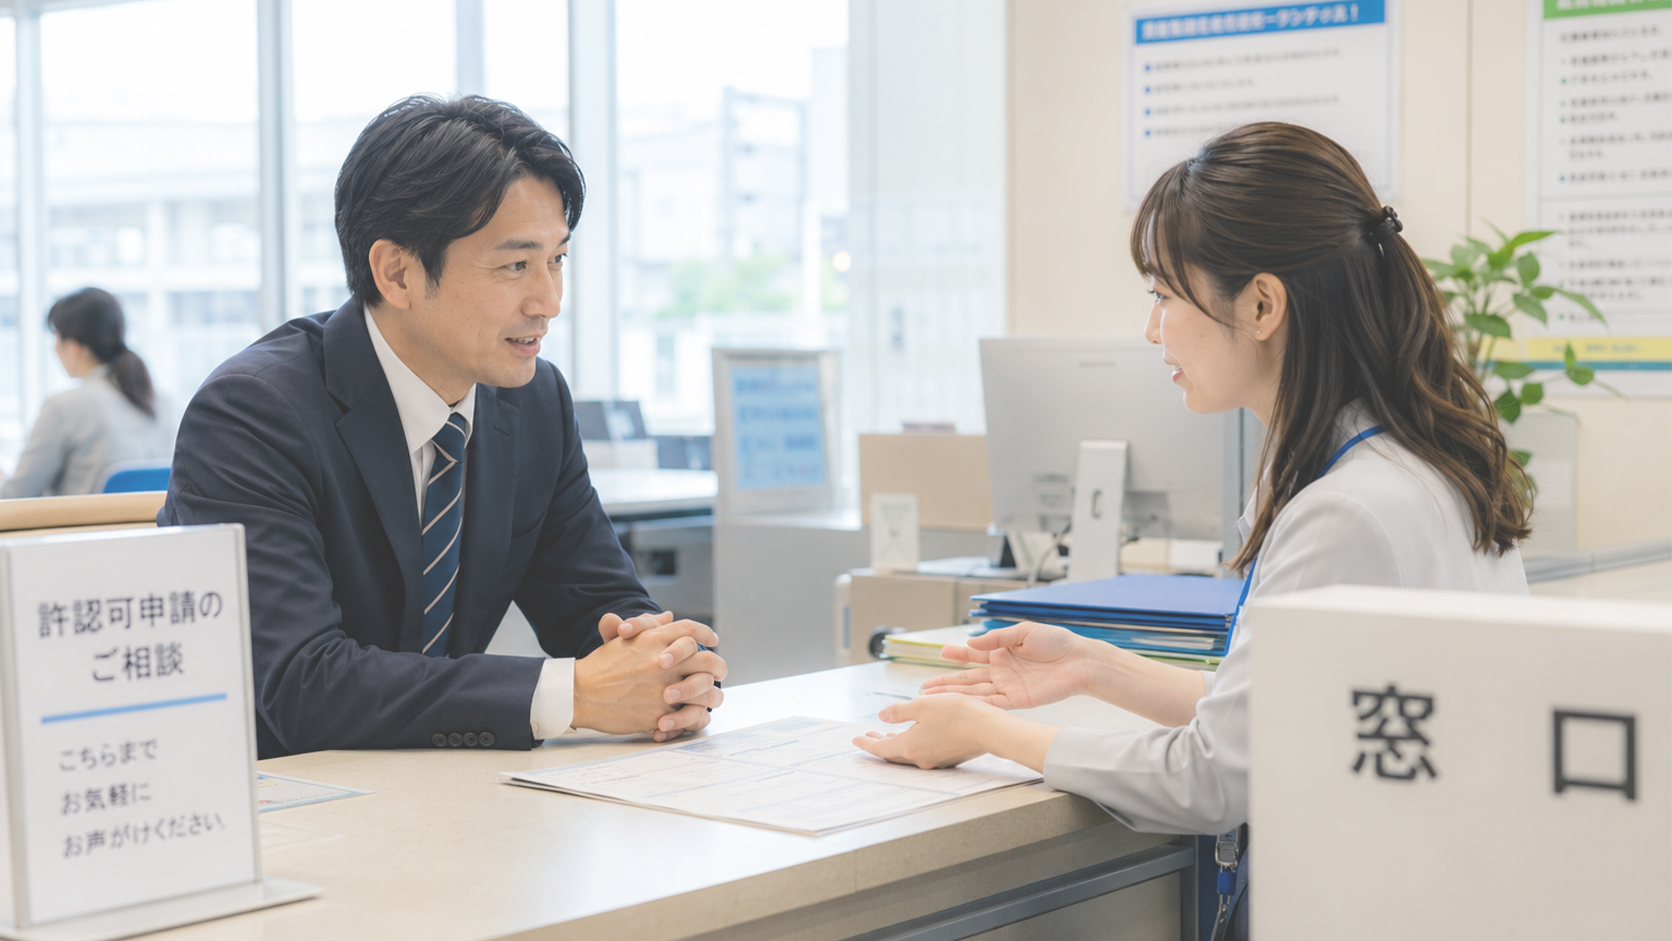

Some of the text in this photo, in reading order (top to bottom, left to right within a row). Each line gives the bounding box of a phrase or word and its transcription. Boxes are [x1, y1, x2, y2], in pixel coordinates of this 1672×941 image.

[38, 590, 223, 638] 許認可申請の
[93, 641, 184, 682] ご相談
[59, 738, 158, 772] こちらまで
[1351, 683, 1639, 803] 窓口
[60, 781, 152, 817] お気軽に
